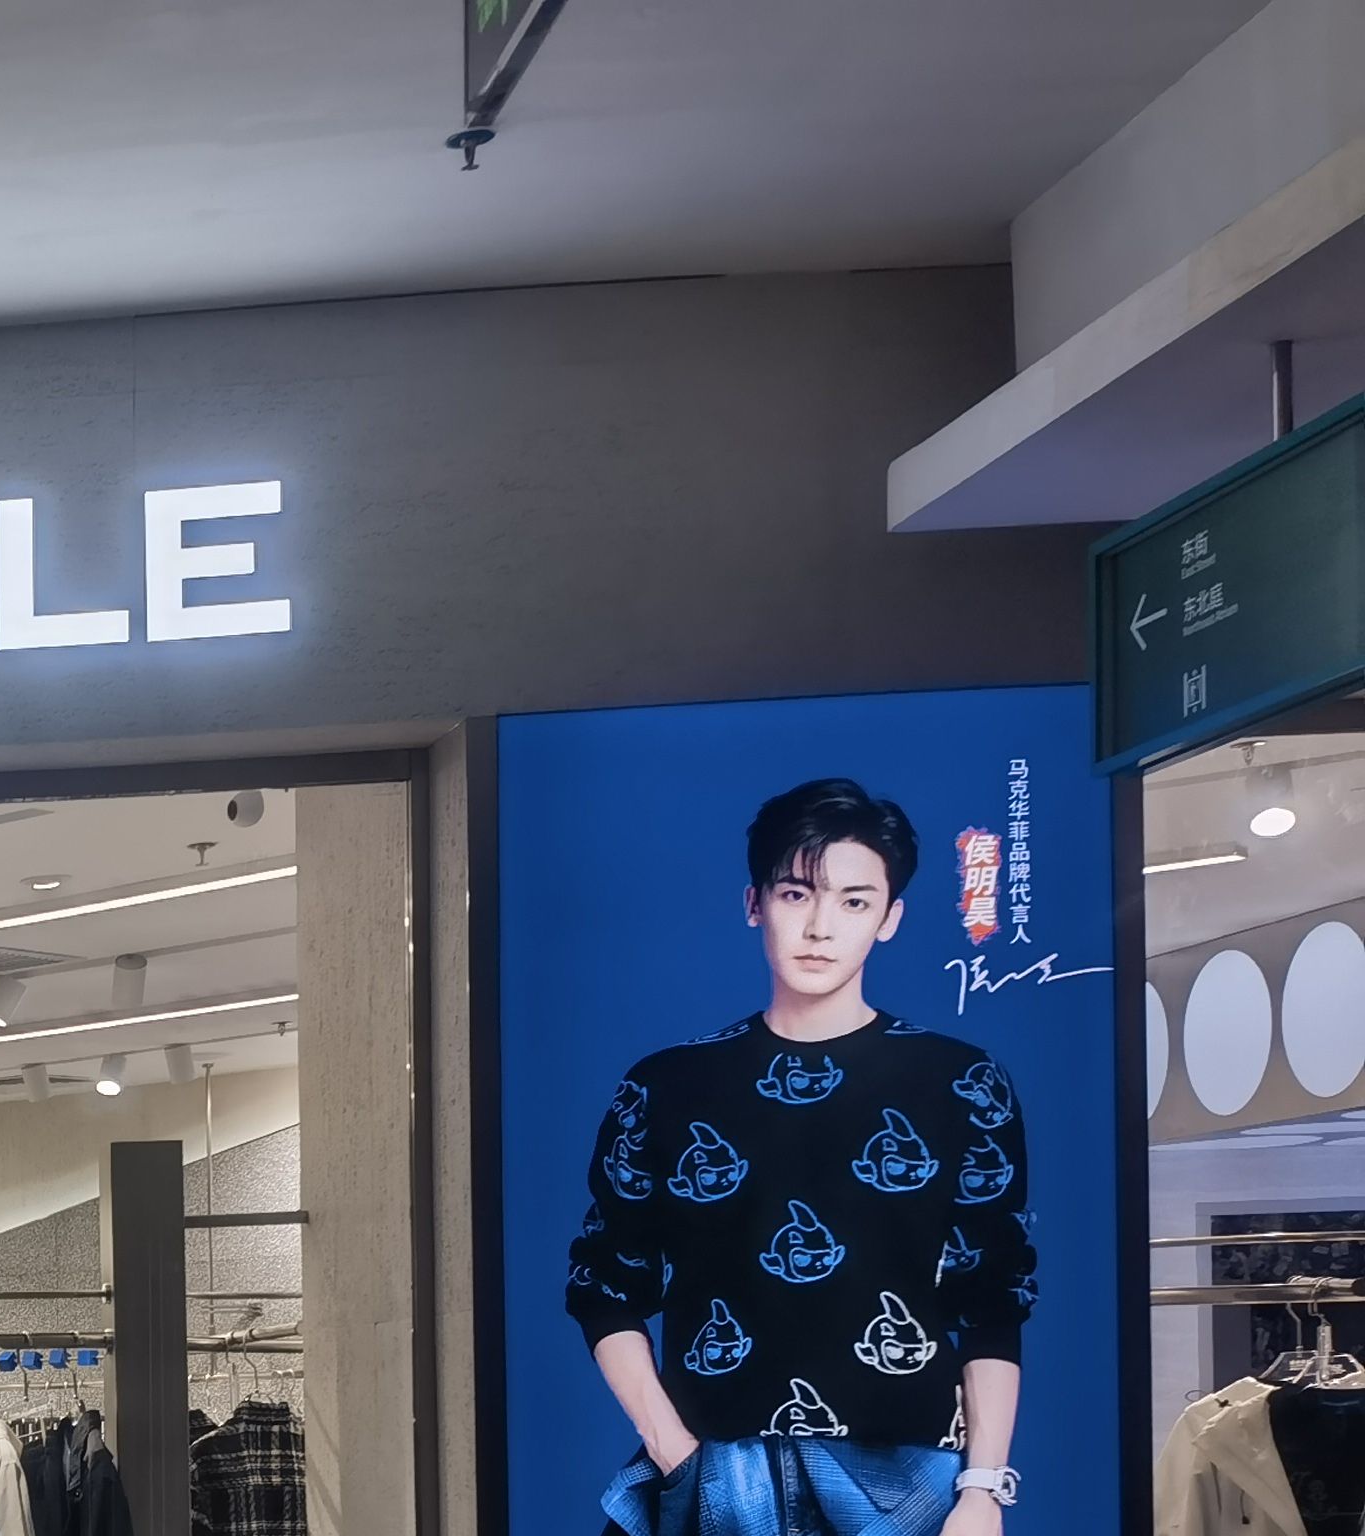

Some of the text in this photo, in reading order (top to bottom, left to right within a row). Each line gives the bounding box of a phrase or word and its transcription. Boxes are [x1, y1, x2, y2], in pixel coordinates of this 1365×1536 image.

[963, 834, 999, 928] 侯明昊
[1007, 758, 1032, 945] 马克华菲品牌代言人
